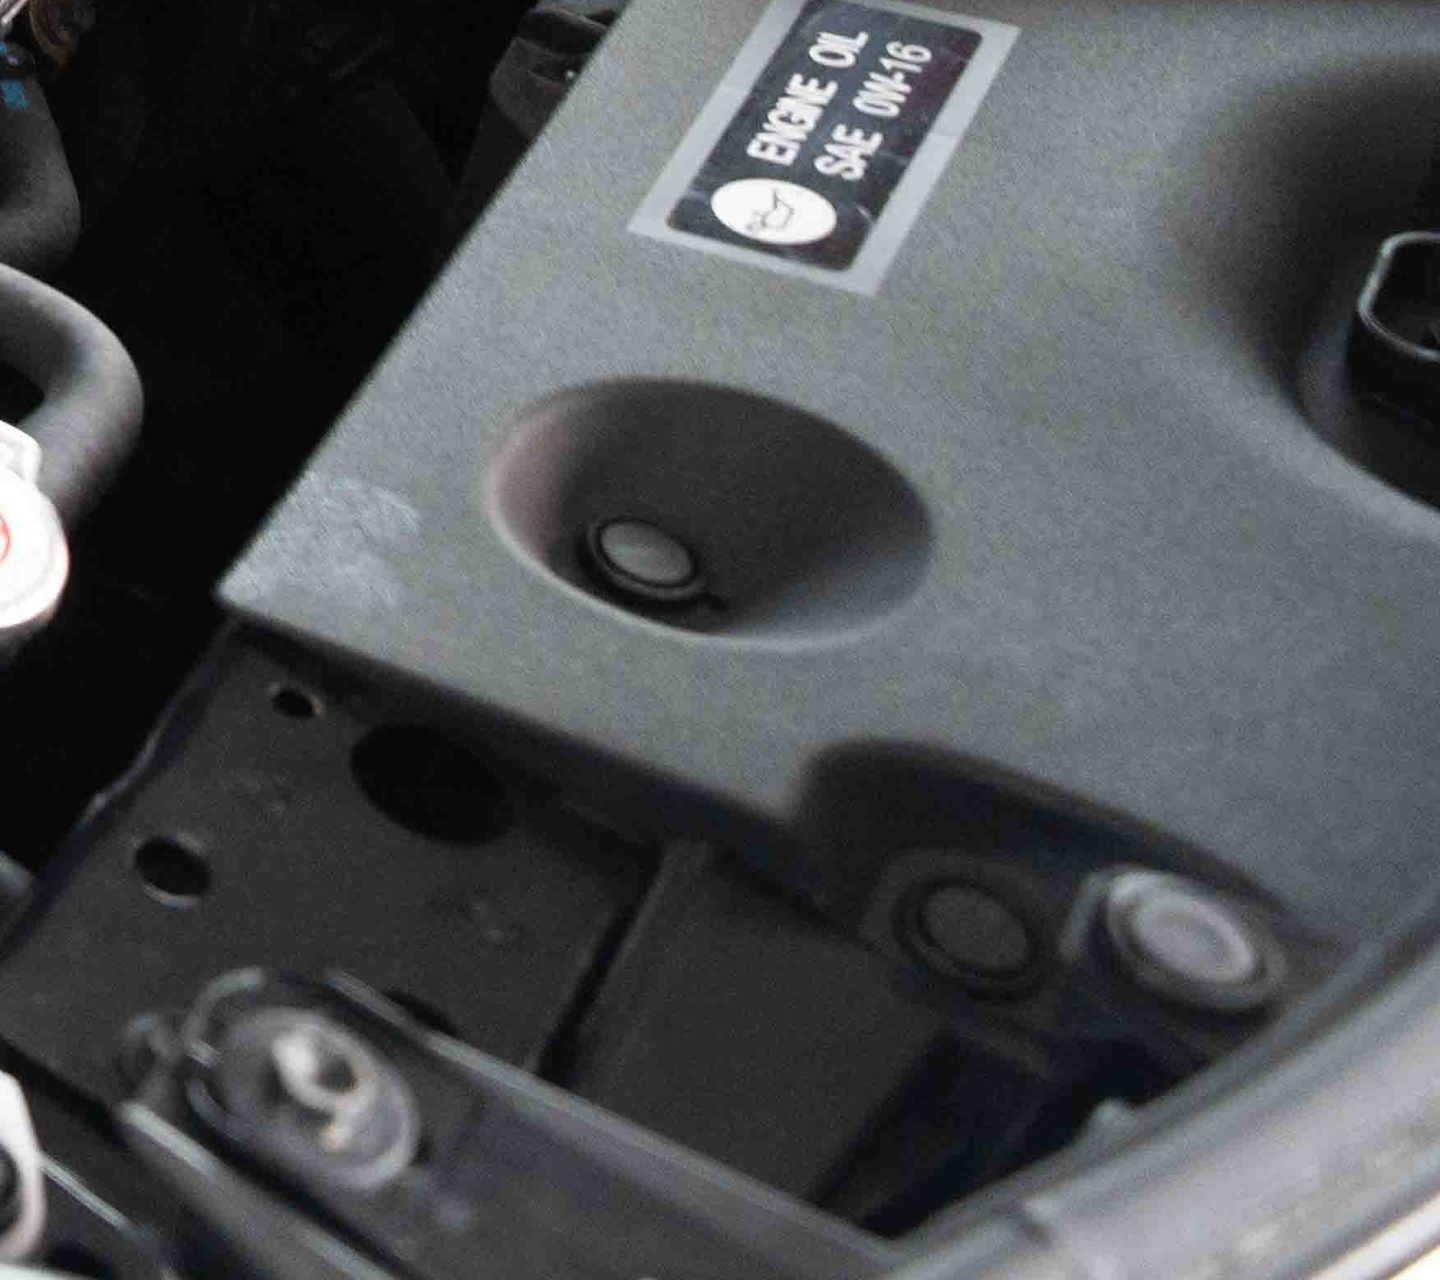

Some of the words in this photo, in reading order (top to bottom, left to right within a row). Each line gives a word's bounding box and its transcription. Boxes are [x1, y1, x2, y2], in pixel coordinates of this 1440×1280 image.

[747, 74, 838, 166] ENGINE
[809, 31, 869, 68] OIL
[813, 124, 883, 180] SAE
[853, 42, 931, 118] 0W-16
